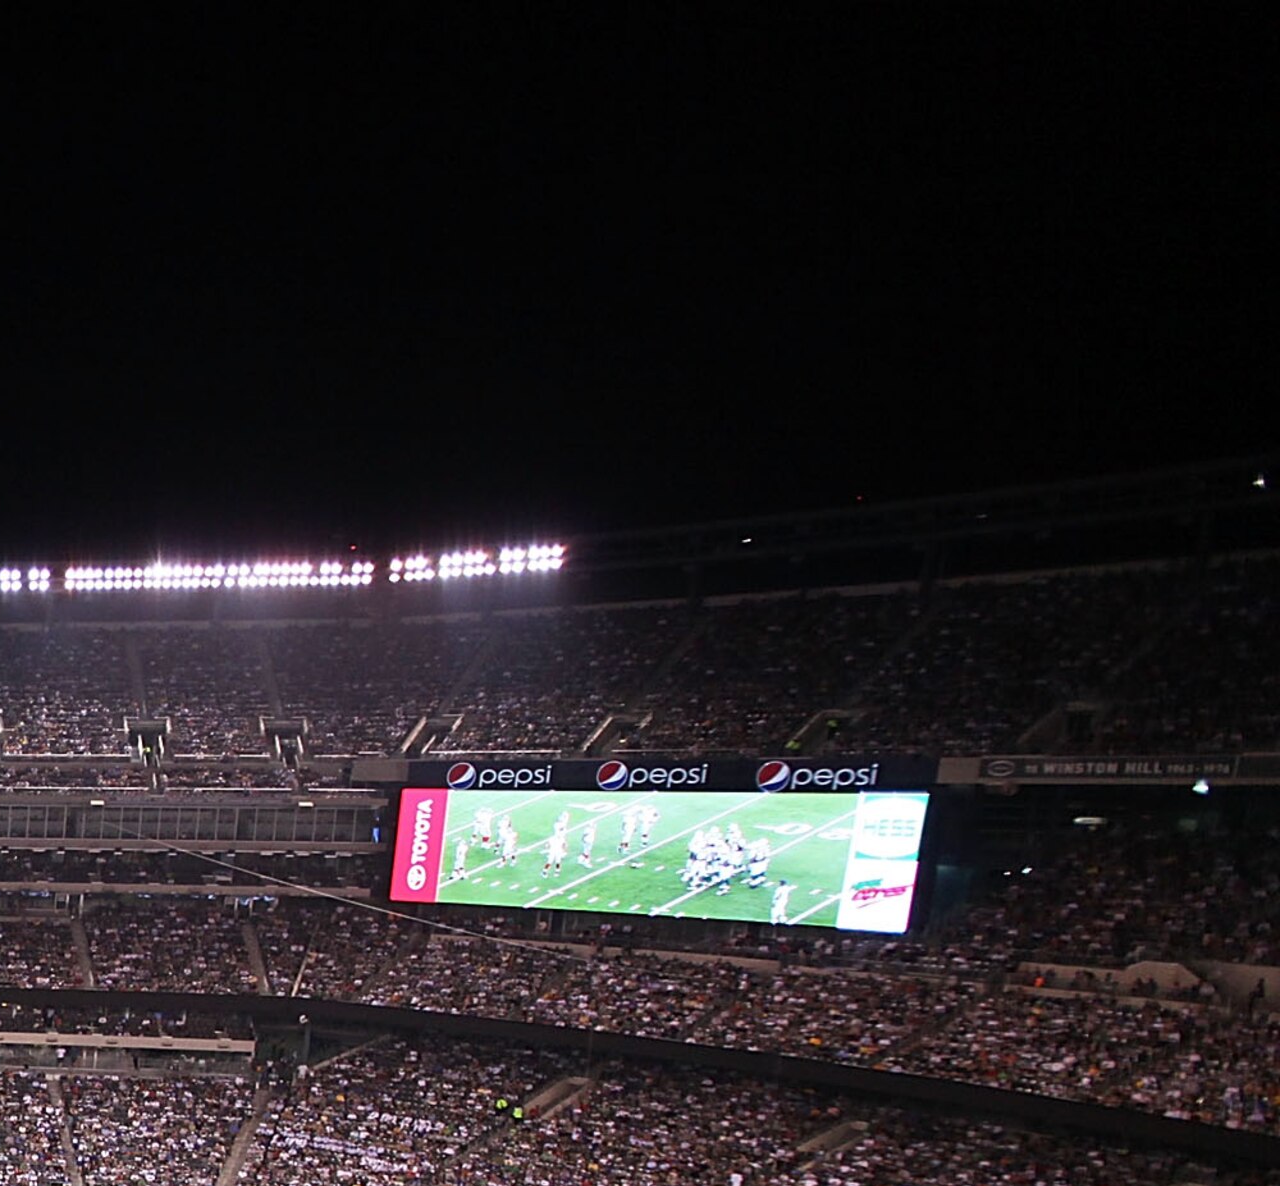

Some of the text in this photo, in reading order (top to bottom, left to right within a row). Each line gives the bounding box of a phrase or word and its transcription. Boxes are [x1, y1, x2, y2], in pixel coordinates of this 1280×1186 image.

[479, 763, 552, 789] pepsi
[630, 763, 708, 789] pepsi
[791, 764, 878, 792] pepsi
[1043, 761, 1163, 775] WINSTON HILL
[411, 799, 435, 864] TOYOTA
